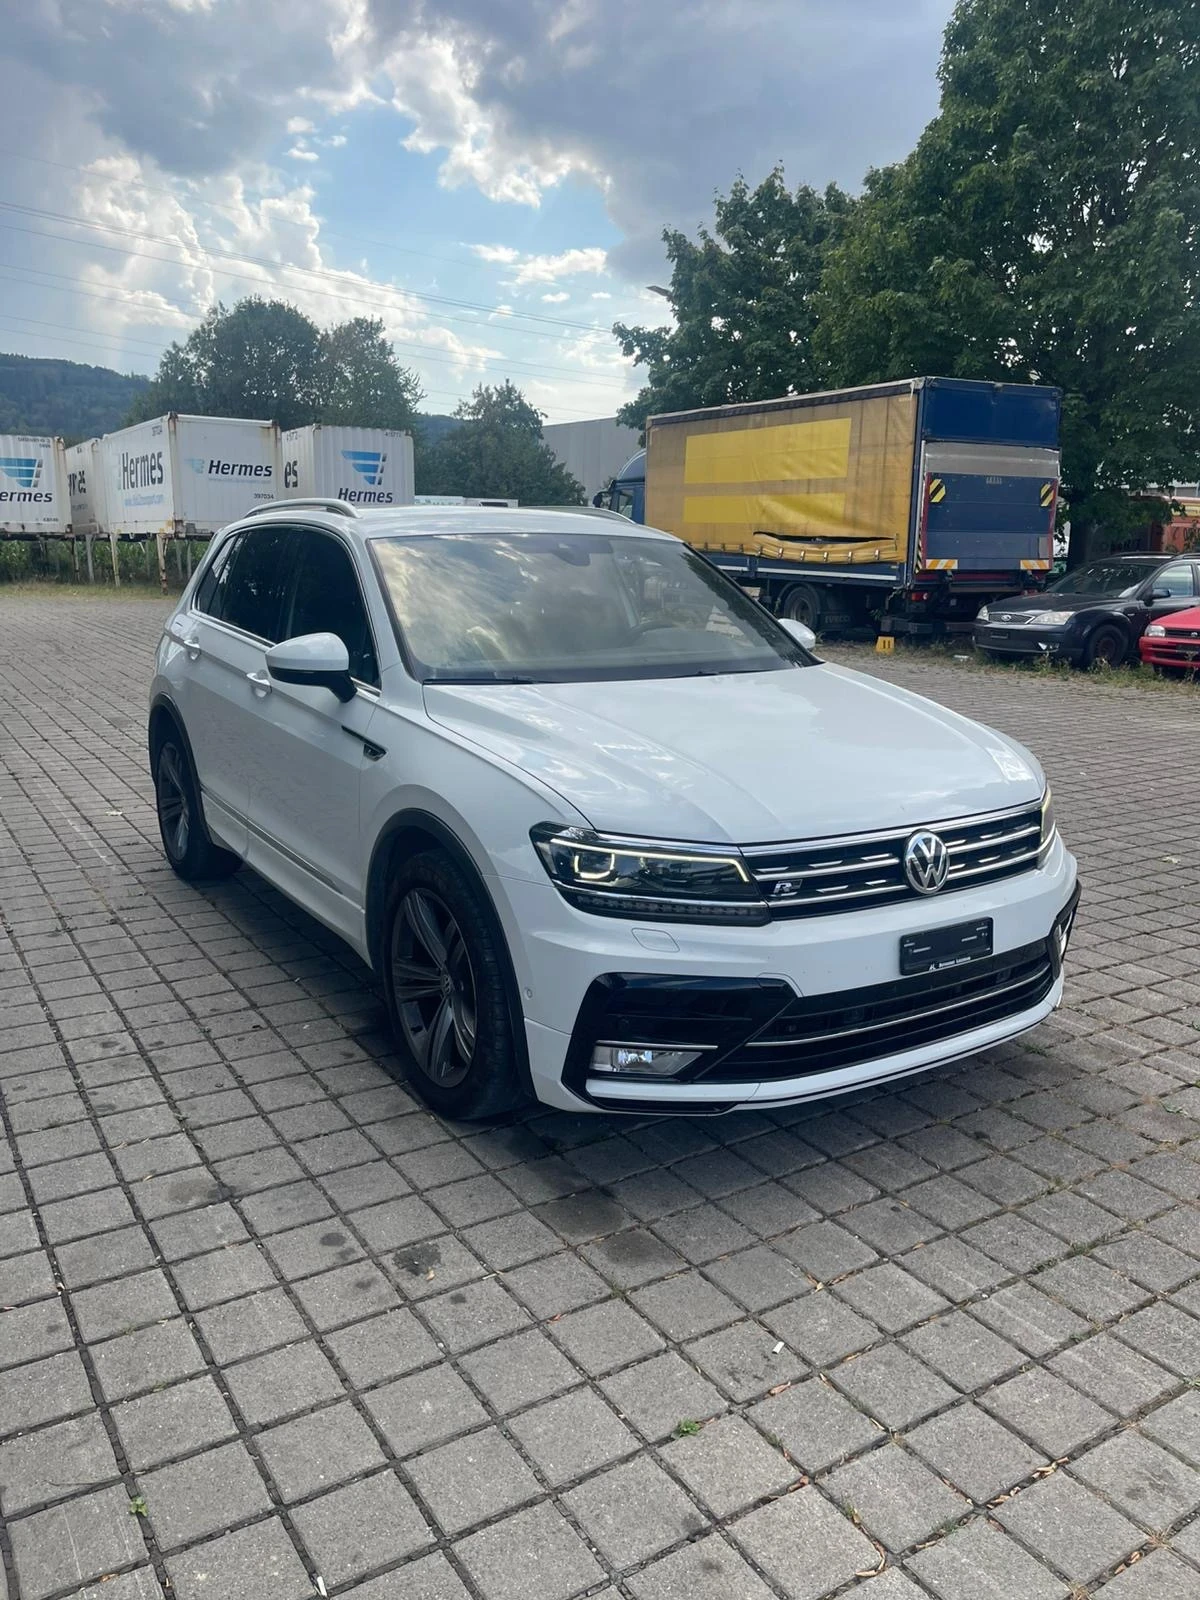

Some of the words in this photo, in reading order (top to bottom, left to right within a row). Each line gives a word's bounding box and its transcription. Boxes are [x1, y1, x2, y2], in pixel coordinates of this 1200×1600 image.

[122, 451, 164, 490] Hermes
[208, 459, 273, 477] Hermes
[338, 487, 393, 504] Hermes
